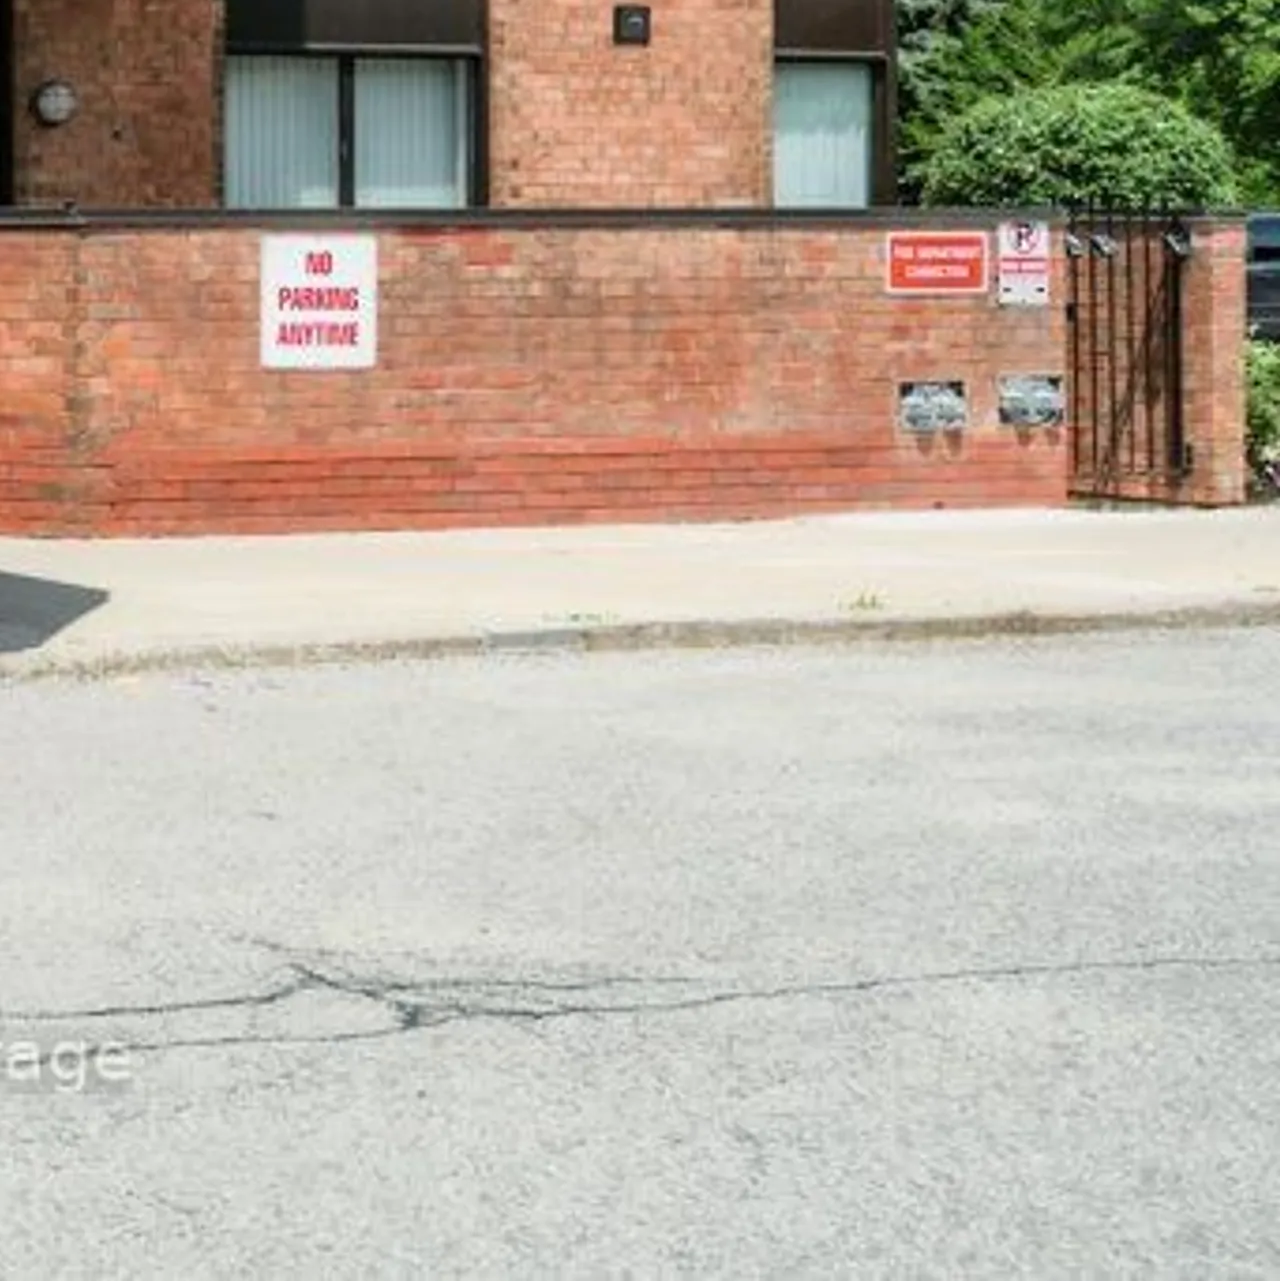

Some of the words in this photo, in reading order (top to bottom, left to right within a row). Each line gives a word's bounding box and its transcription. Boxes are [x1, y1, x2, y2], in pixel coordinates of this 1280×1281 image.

[304, 249, 334, 276] NO
[277, 286, 360, 311] PARKING
[276, 322, 359, 346] ANYTIME
